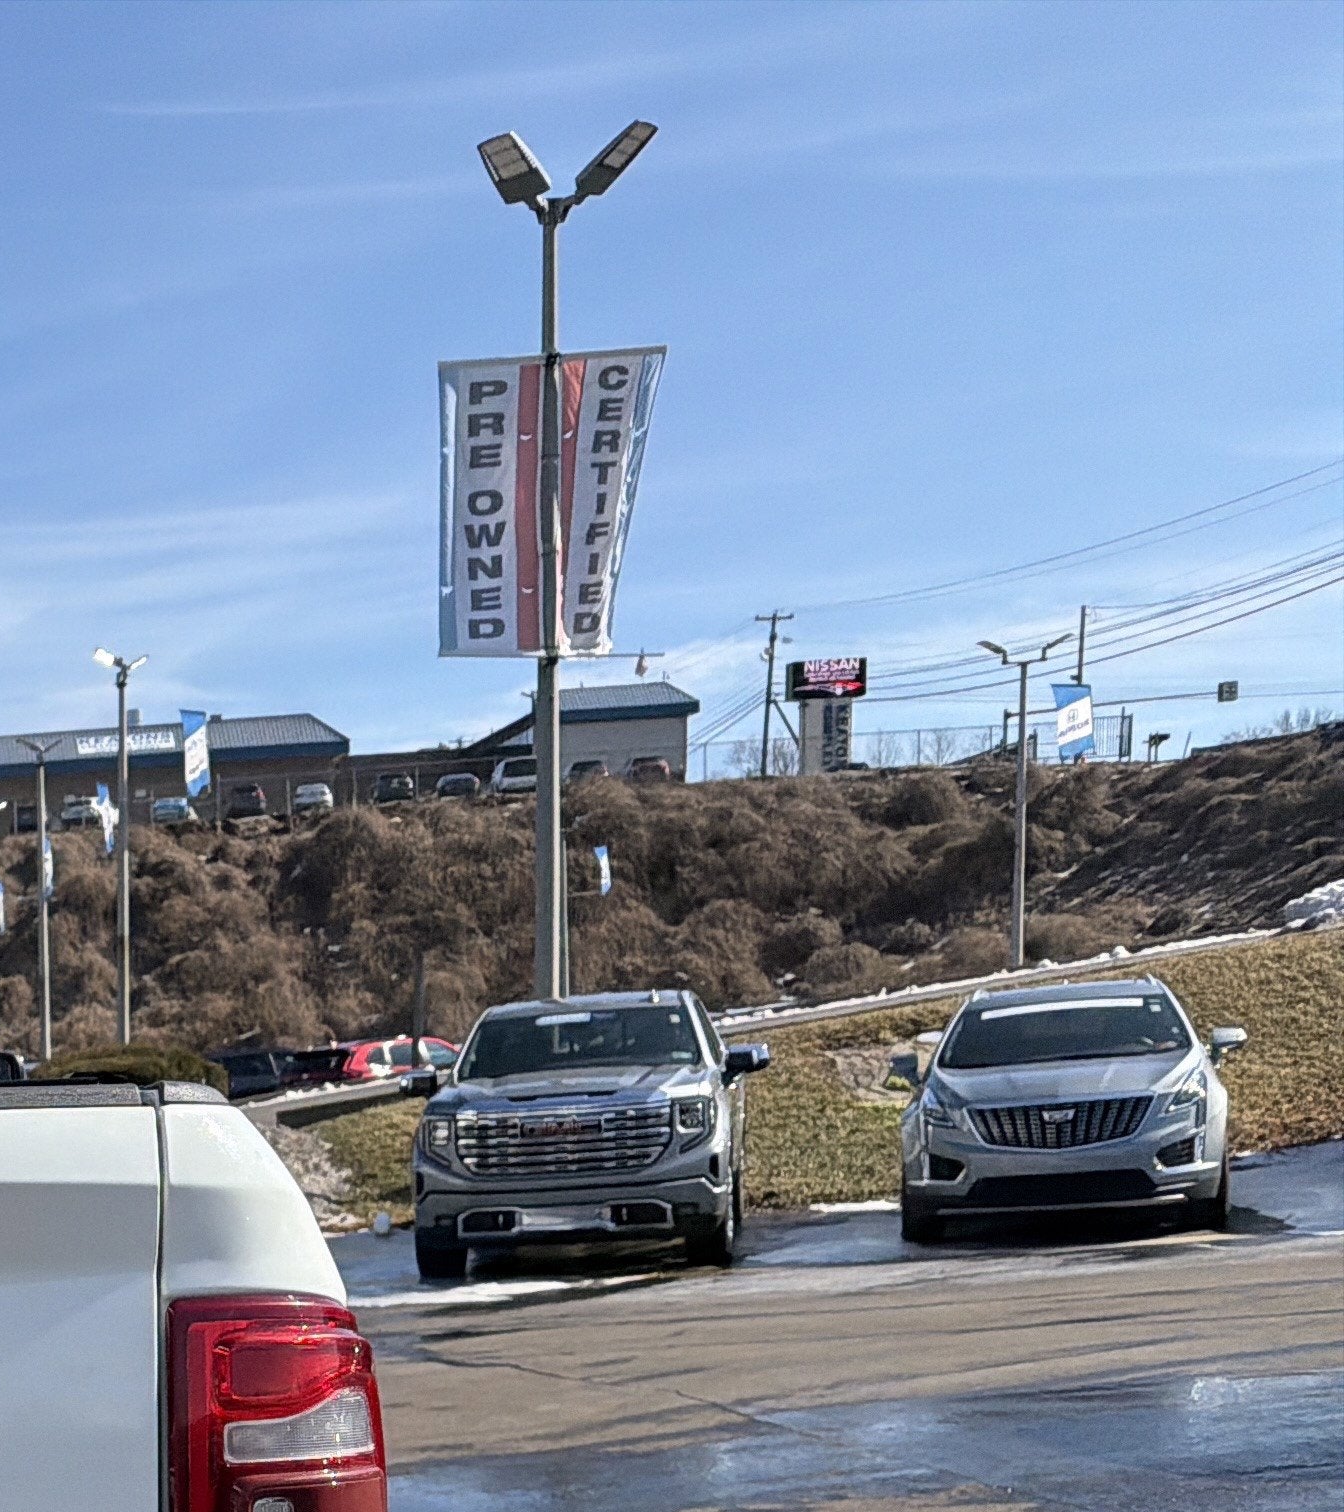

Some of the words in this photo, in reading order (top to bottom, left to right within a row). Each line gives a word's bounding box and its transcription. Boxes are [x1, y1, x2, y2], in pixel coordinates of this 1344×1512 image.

[467, 380, 508, 470] PRE
[572, 364, 629, 634] CERTIFIED
[464, 489, 507, 640] OWNED
[803, 658, 860, 672] NISSAN
